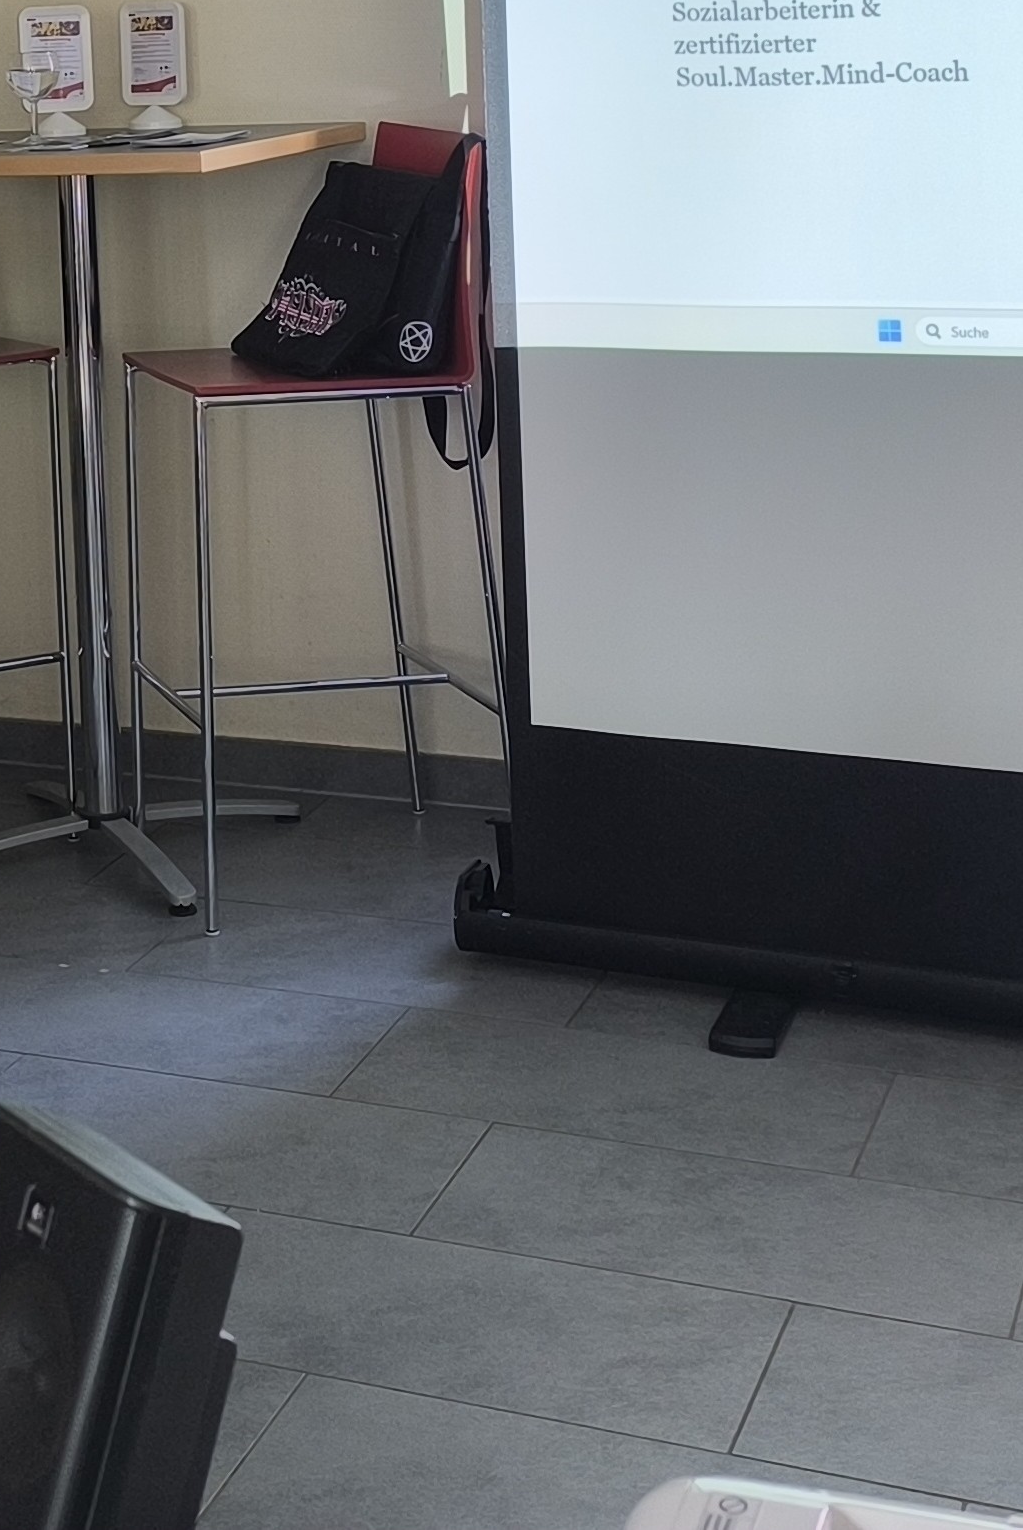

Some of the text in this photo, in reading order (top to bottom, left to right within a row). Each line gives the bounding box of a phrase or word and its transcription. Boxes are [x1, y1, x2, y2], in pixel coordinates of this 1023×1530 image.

[673, 32, 817, 55] zertifizierter
[676, 59, 970, 87] Soul.Master.Mind-Coach
[950, 326, 990, 339] Suche
